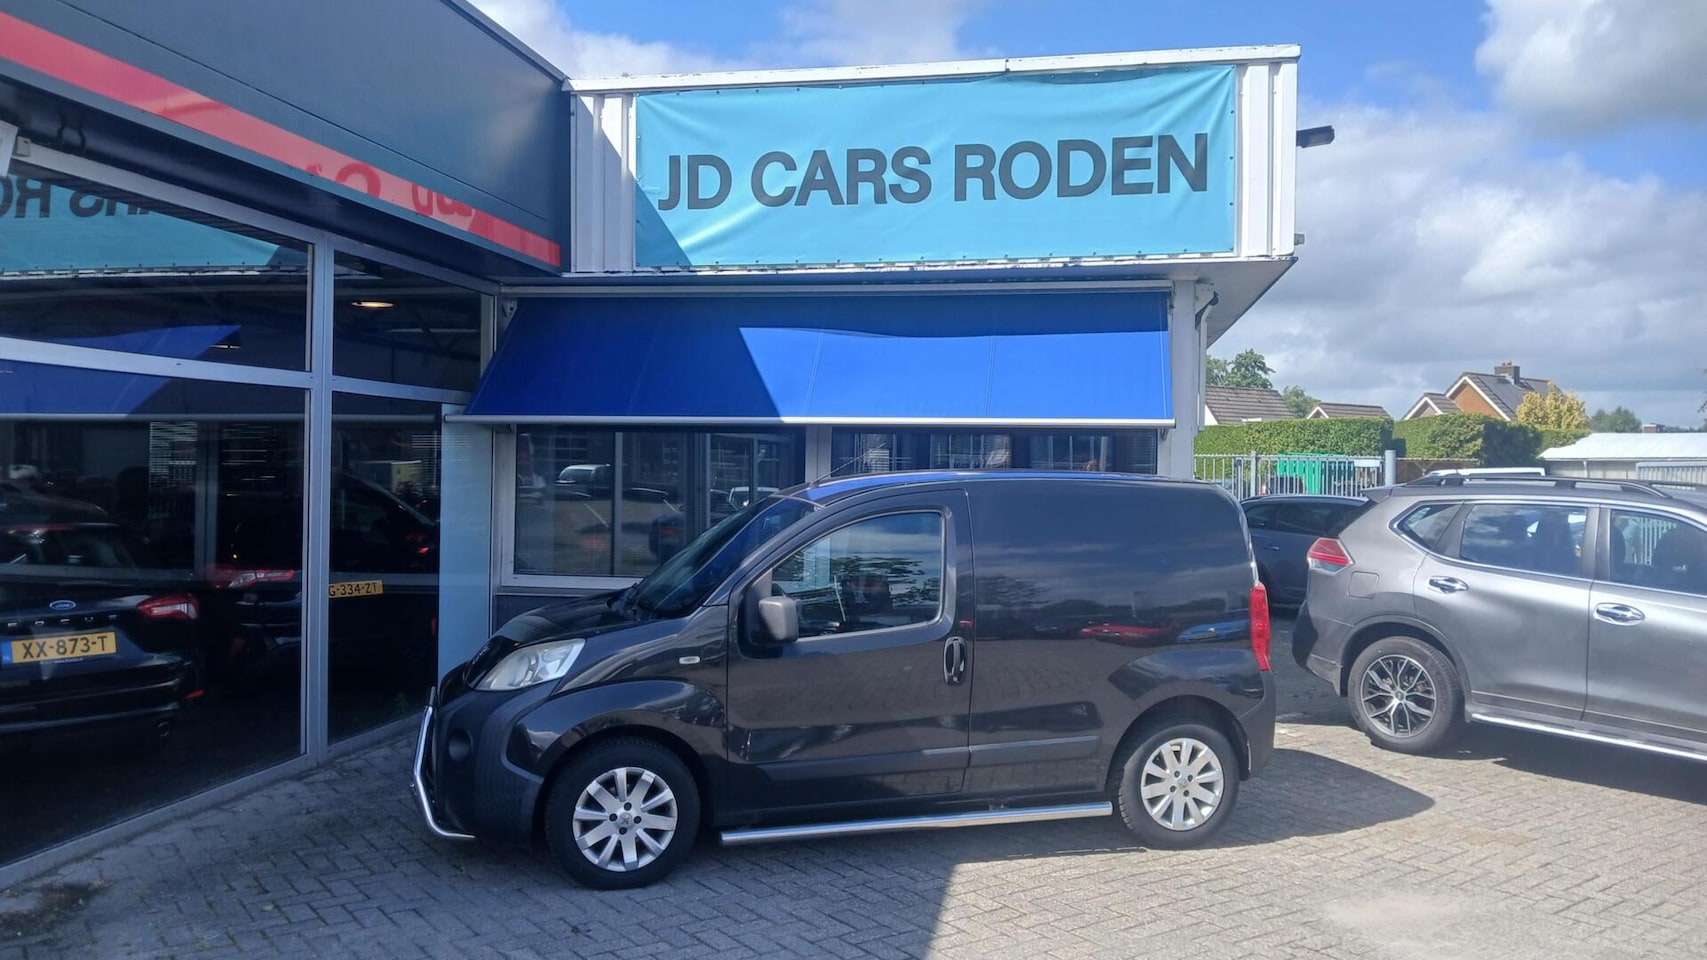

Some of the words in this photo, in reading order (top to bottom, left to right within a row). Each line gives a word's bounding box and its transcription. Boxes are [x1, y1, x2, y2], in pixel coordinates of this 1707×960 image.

[658, 154, 732, 211] JD
[751, 145, 932, 207] CARS
[954, 132, 1208, 202] RODEN
[22, 635, 108, 659] XX-873-T
